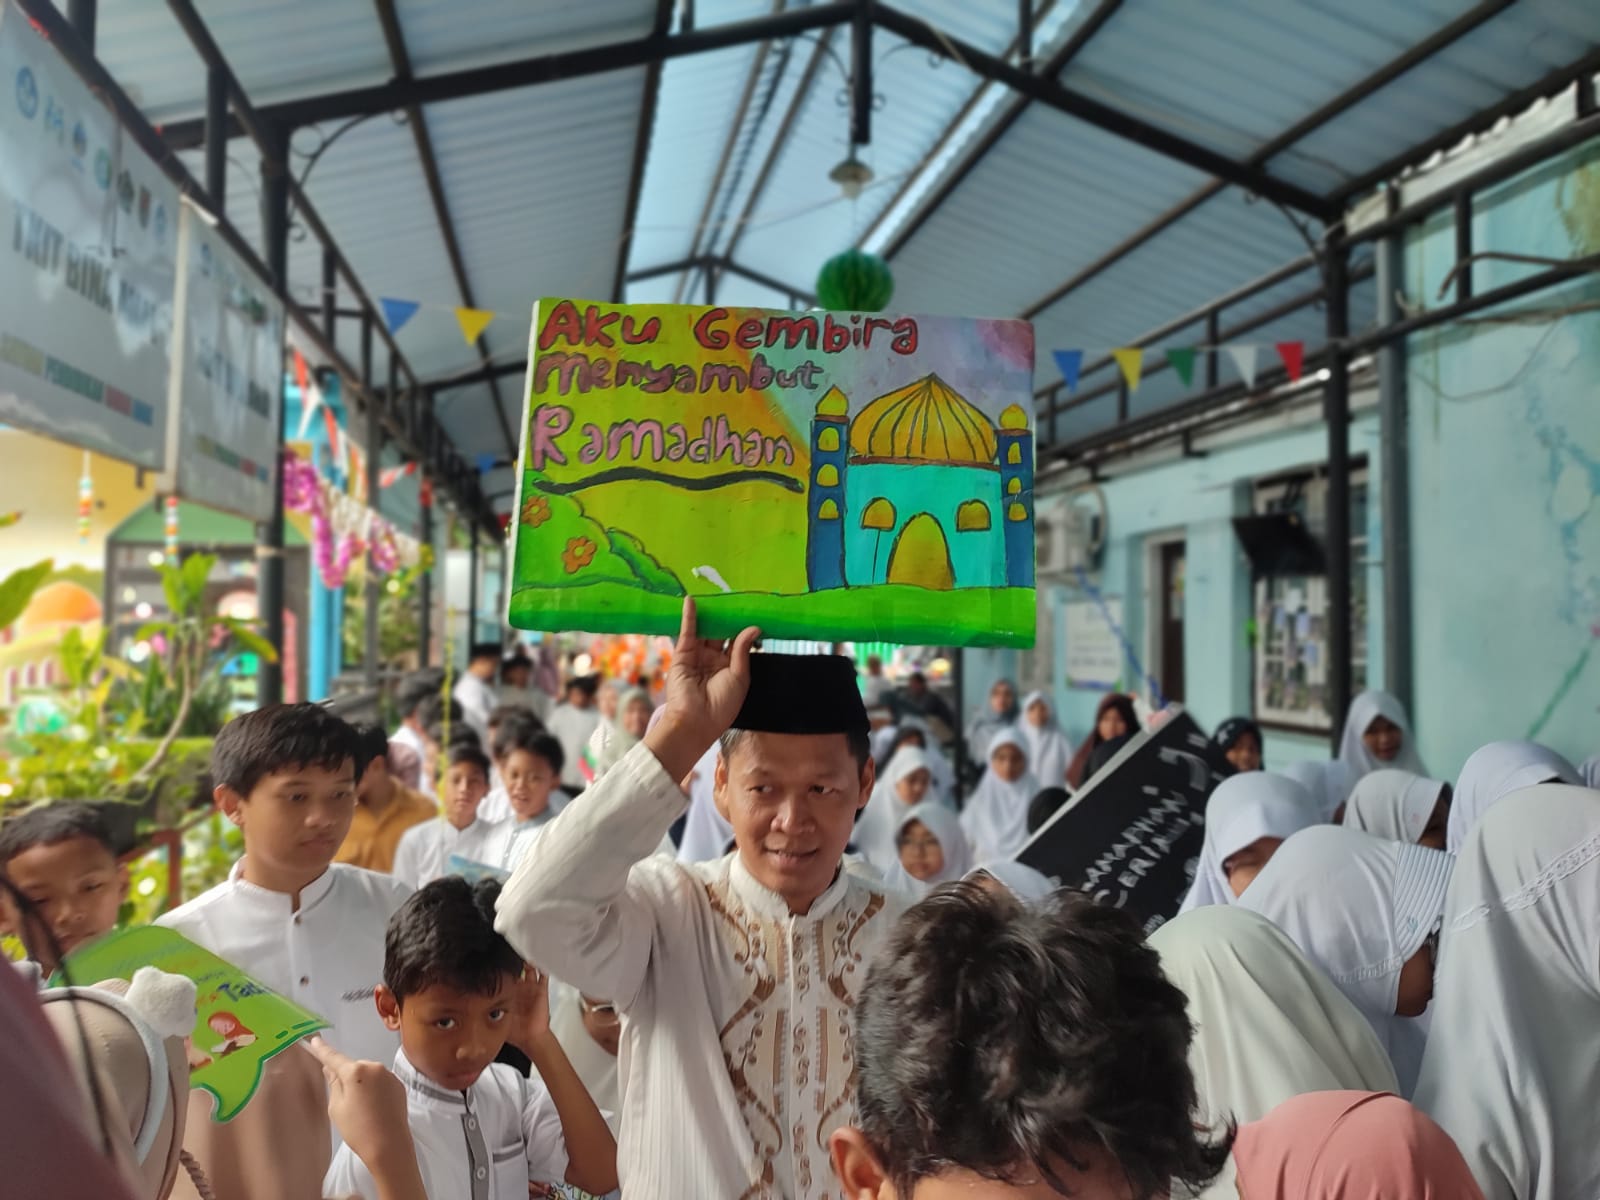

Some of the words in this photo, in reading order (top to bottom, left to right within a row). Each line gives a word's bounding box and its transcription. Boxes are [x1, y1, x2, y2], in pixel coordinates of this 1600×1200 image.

[538, 300, 661, 350] Aku
[694, 308, 919, 355] Gembira
[531, 403, 795, 471] Ramadhan
